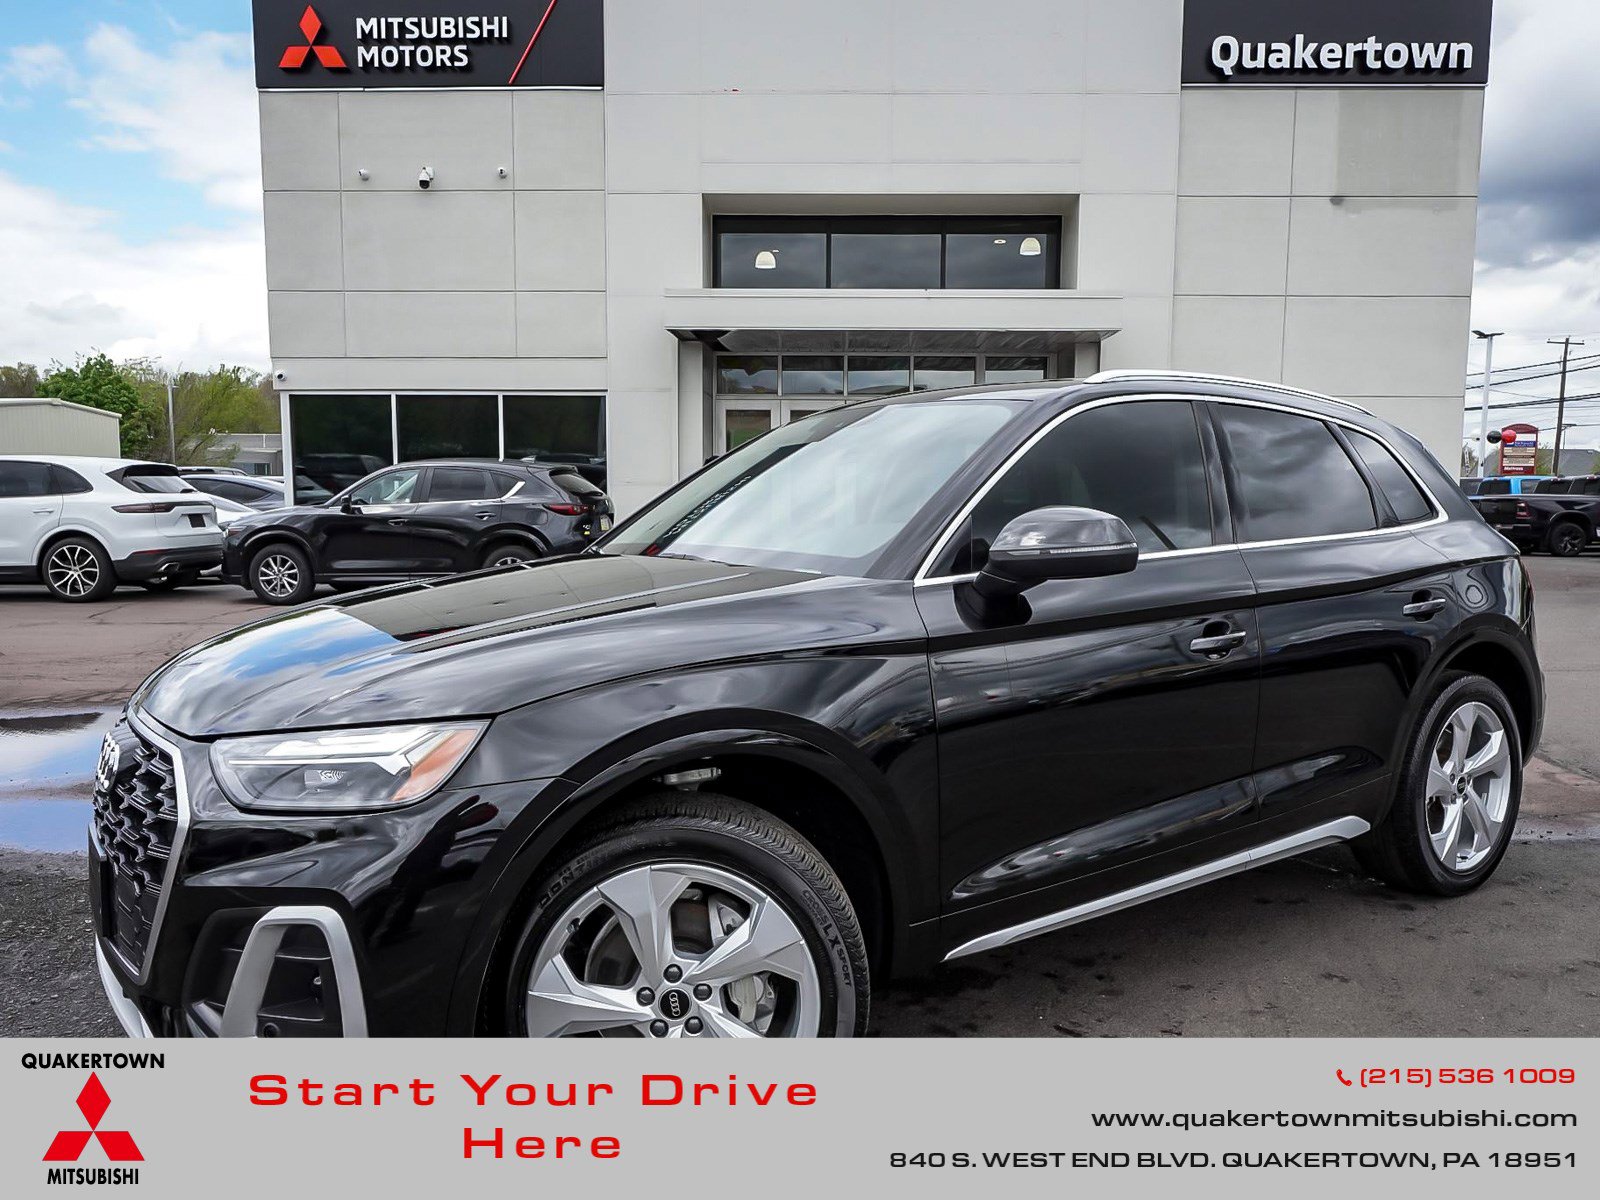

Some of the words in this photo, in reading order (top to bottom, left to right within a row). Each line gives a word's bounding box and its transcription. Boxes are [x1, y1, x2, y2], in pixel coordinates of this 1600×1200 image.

[355, 16, 509, 40] MITSUBISHI
[357, 44, 469, 68] MOTORS
[1210, 33, 1474, 76] Quakertown
[836, 948, 852, 987] SPORT
